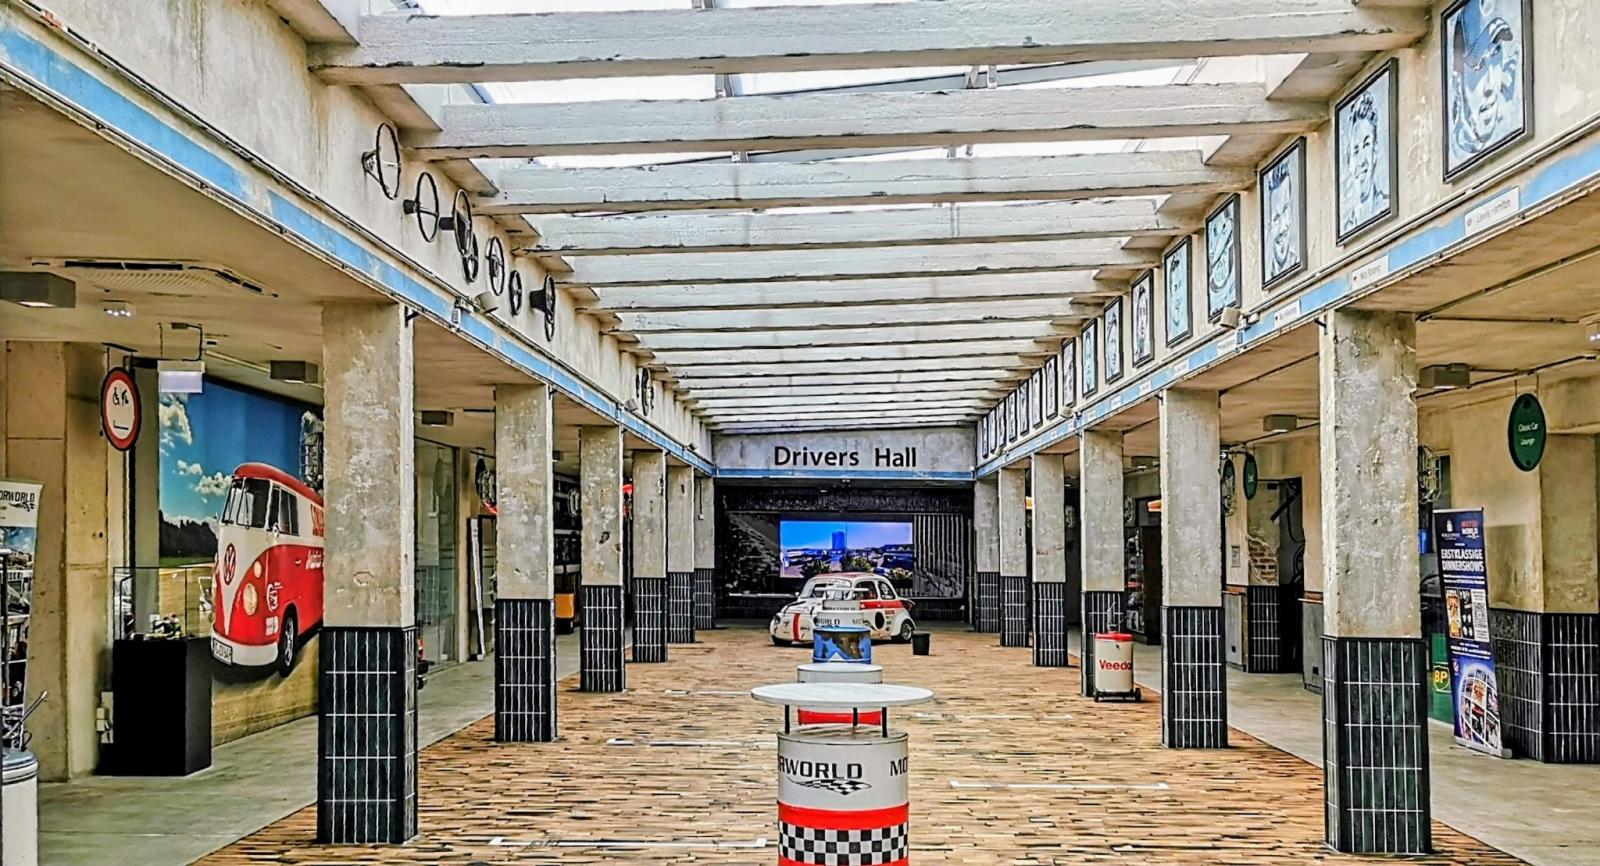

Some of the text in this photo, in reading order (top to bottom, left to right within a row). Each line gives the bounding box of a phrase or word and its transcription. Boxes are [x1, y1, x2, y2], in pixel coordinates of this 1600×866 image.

[774, 446, 916, 467] Drivers Hall
[1441, 549, 1483, 559] ERSTKLASSIGE
[1442, 561, 1484, 572] DINNERSHOWS
[1434, 670, 1448, 683] BP
